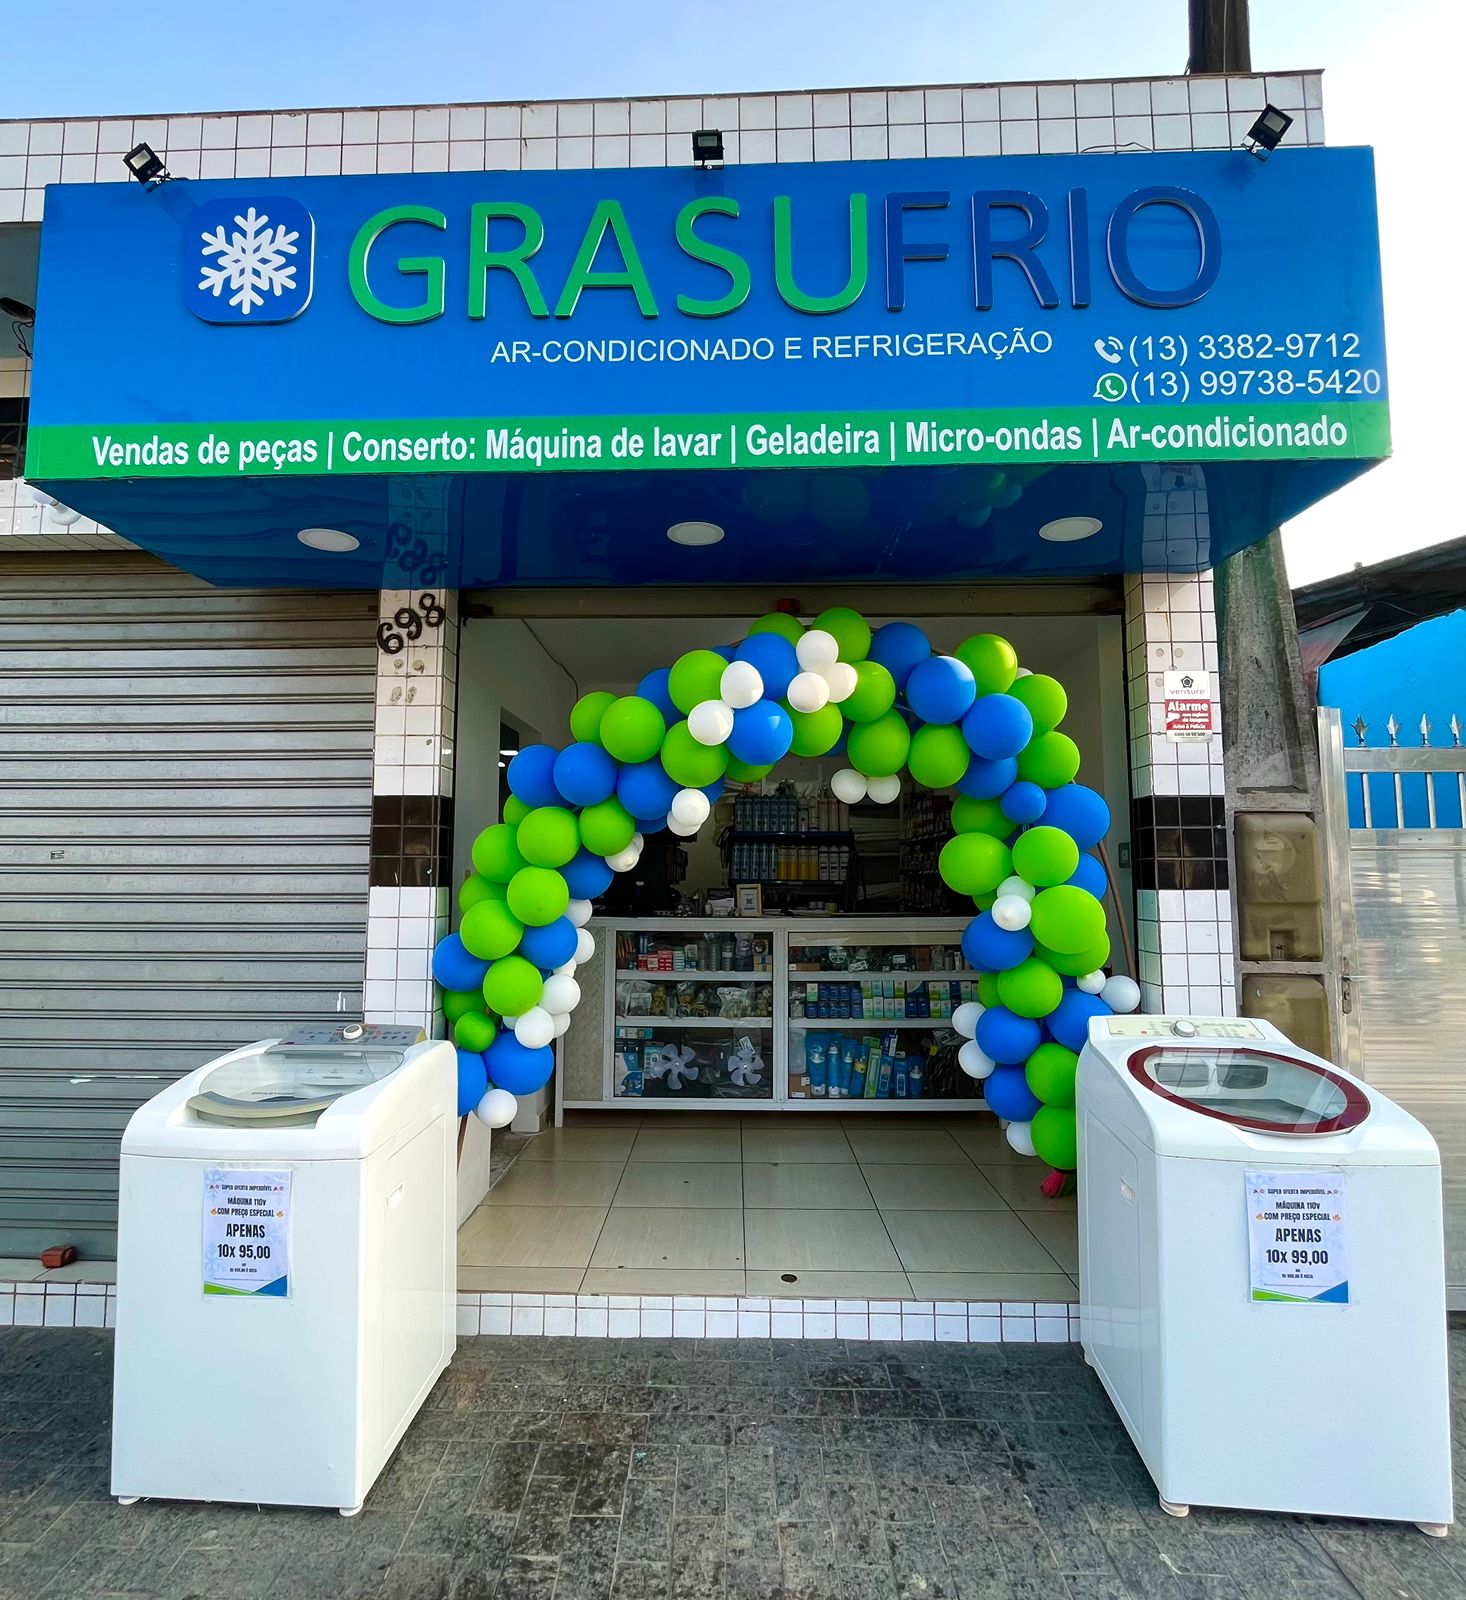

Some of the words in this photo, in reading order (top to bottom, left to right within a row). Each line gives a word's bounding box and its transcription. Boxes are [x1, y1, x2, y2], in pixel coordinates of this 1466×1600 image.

[347, 185, 1222, 326] GRASUFRIO
[490, 336, 775, 364] AR-CONDICIONADO
[784, 337, 803, 360] E
[812, 326, 1053, 361] REFRIGERAÇÃO
[1129, 335, 1190, 366] (13)
[1198, 332, 1361, 361] 3382-9712
[1131, 370, 1191, 403] (13)
[1200, 368, 1382, 398] 99738-5420
[92, 435, 190, 466] Vendas
[197, 433, 230, 465] de
[238, 439, 318, 471] peças
[342, 431, 476, 462] Conserto:
[486, 427, 602, 467] Máquina
[611, 427, 644, 458] de
[653, 426, 722, 457] lavar
[746, 422, 880, 456] Geladeira
[906, 419, 1083, 453] Micro-ondas
[1106, 414, 1348, 449] Ar-condicionado
[377, 593, 446, 654] 698
[1168, 702, 1209, 712] Alarme
[227, 1196, 253, 1206] MÁQUINA
[1275, 1200, 1305, 1210] MÁQUINA
[217, 1207, 230, 1216] COM
[231, 1208, 249, 1219] PREÇO
[250, 1209, 275, 1218] ESPECIAL
[1264, 1212, 1279, 1220] COM
[1280, 1212, 1301, 1223] PREÇO
[1302, 1212, 1331, 1221] ESPECIAL
[226, 1223, 266, 1239] APENAS
[1275, 1228, 1322, 1243] APENAS
[217, 1243, 236, 1258] 10x
[239, 1244, 271, 1260] 95,00
[1265, 1249, 1288, 1264] 10x
[1291, 1249, 1329, 1266] 99,00
